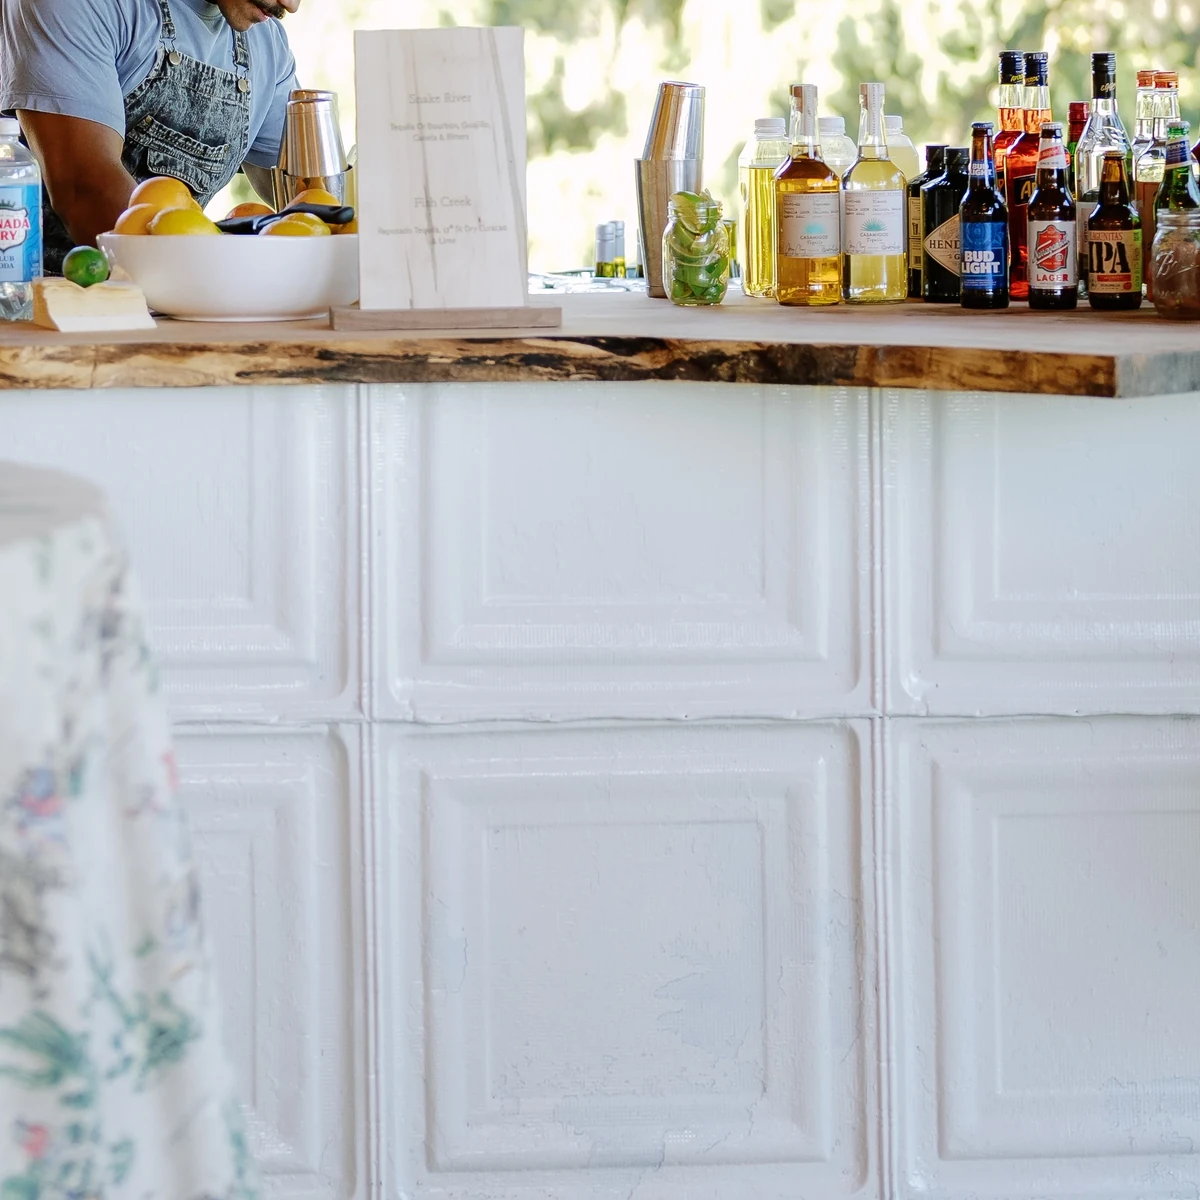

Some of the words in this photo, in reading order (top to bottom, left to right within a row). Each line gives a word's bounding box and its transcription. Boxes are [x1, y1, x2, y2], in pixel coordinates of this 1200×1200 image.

[409, 93, 440, 104] Snake
[444, 92, 471, 103] River
[441, 195, 471, 207] Creek
[964, 250, 995, 262] BUD
[1089, 241, 1131, 274] IPA
[961, 261, 1000, 274] LIGHT
[1037, 274, 1068, 282] LAGER
